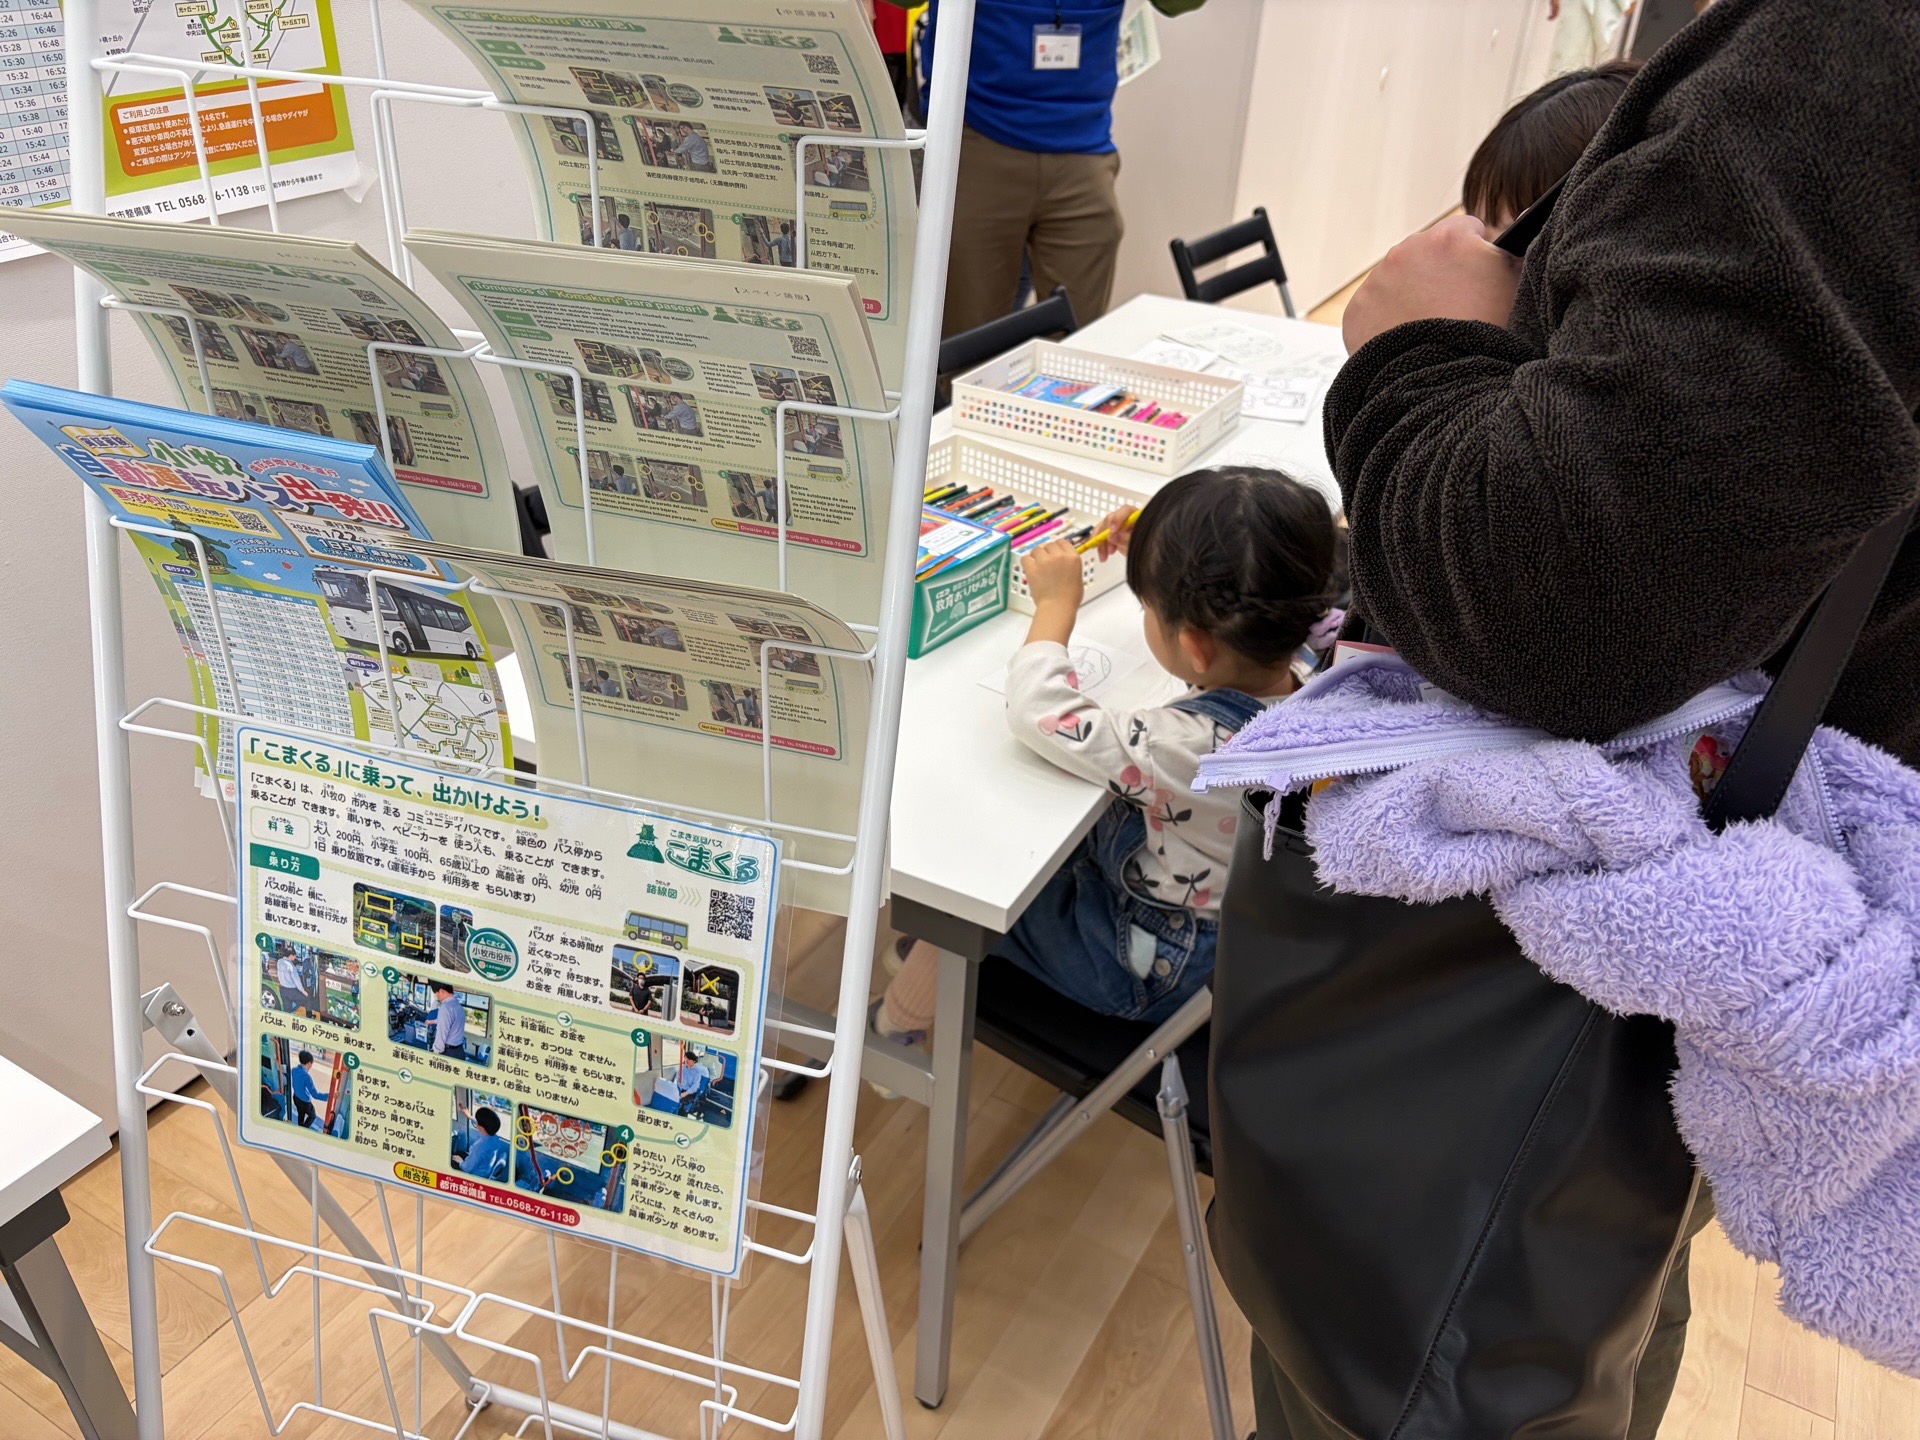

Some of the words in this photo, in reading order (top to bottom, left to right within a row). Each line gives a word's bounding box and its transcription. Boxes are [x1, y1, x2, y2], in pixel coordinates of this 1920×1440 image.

[31, 12, 52, 20] 16:44
[34, 25, 56, 34] 16:46
[38, 39, 60, 48] 16:48
[3, 58, 25, 66] 15:30
[42, 53, 63, 62] 16:50
[7, 71, 29, 80] 15:32
[46, 67, 66, 76] 16:52
[10, 86, 32, 94] 15:34
[14, 99, 36, 108] 15:36
[123, 106, 169, 120] ご利用上の注意
[18, 113, 39, 122] 15:38
[22, 126, 43, 136] 15:40
[26, 140, 46, 149] 15:42
[29, 153, 50, 162] 15:44
[32, 166, 53, 176] 15:46
[36, 179, 57, 189] 15:48
[40, 191, 60, 201] 15:50
[155, 198, 176, 212] TEL
[178, 185, 250, 208] 0568-6-1138
[625, 300, 653, 309] para
[656, 302, 701, 313] pasear!
[152, 440, 246, 479] 小牧
[322, 529, 357, 541] 1/22
[251, 771, 312, 795] 「こまくる」は、
[320, 788, 346, 804] 小牧の
[351, 796, 376, 812] 市内を
[383, 804, 400, 818] 走る
[407, 810, 505, 842] コミュニティバスです。
[516, 834, 546, 850] 緑色の
[553, 842, 602, 862] バス停から
[268, 819, 293, 835] 料金
[250, 788, 295, 808] 乗ることが
[302, 800, 340, 818] できます。
[347, 812, 384, 831] 車いすや、
[393, 824, 447, 846] ベビーカーを
[454, 838, 495, 857] 使う人も、
[504, 849, 553, 869] 乗ることが
[561, 861, 605, 880] できます。
[268, 854, 300, 872] 乗り方
[313, 824, 330, 836] 大人
[336, 829, 365, 846] 200円、
[370, 839, 397, 855] 小学生
[404, 848, 431, 863] 100円、
[439, 855, 489, 876] 65歳以上の
[495, 868, 525, 884] 高齢者
[559, 881, 579, 896] 幼児
[585, 887, 601, 901] 0円
[314, 840, 325, 852] 1日
[442, 873, 479, 891] 利用券を
[665, 838, 760, 887] こまくる
[264, 879, 302, 897] バスの前と
[308, 890, 326, 903] 横に、
[646, 882, 677, 900] 路線図
[264, 895, 304, 914] 路線番号と
[308, 906, 347, 925] 最終行先が
[264, 911, 321, 934] 書いてあります。
[260, 936, 267, 946] 1
[528, 928, 554, 943] バスが
[560, 935, 603, 955] 来る時間が
[471, 945, 511, 964] 小牧市役所
[527, 945, 580, 966] 近くなったら、
[387, 969, 395, 981] 2
[526, 962, 560, 979] バス停で
[566, 971, 604, 989] 待ちます。
[526, 978, 551, 993] お金を
[557, 986, 603, 1006] 用意します。
[260, 1013, 286, 1029] バスは、
[291, 1021, 306, 1033] 前の
[312, 1026, 339, 1041] ドアから
[343, 1035, 375, 1052] 乗ります。
[498, 1014, 515, 1026] 先に
[520, 1019, 554, 1036] 料金箱に
[560, 1028, 585, 1043] お金を
[636, 1031, 644, 1043] 3
[498, 1030, 534, 1048] 入れます。
[540, 1040, 573, 1057] おつりは
[578, 1050, 616, 1067] でません。
[347, 1054, 355, 1066] 5
[392, 1048, 423, 1065] 運転手に
[429, 1058, 460, 1075] 利用券を
[497, 1046, 538, 1064] 運転手から
[544, 1057, 577, 1073] 利用券を
[582, 1066, 625, 1085] もらいます。
[356, 1072, 390, 1089] 降ります。
[497, 1062, 529, 1078] 同じ日に
[534, 1071, 567, 1088] もう一度
[572, 1081, 618, 1101] 乗るときは、
[358, 1088, 379, 1101] ドアが
[384, 1095, 434, 1117] 2つあるバスは
[356, 1103, 386, 1119] 後ろから
[390, 1112, 423, 1130] 降ります。
[636, 1112, 674, 1130] 座ります。
[356, 1118, 378, 1132] ドアが
[383, 1125, 425, 1145] 1つのバスは
[620, 1127, 629, 1140] 4
[355, 1134, 377, 1148] 前から
[382, 1141, 415, 1159] 降ります。
[632, 1146, 666, 1163] 降りたい
[671, 1156, 705, 1173] バス停の
[402, 1168, 430, 1185] 問合先
[439, 1179, 486, 1200] 都市整備課
[632, 1161, 681, 1183] アナウンスが
[686, 1176, 724, 1194] 流れたら、
[631, 1177, 680, 1199] 降車ボタンを
[685, 1192, 723, 1211] 押します。
[630, 1193, 666, 1211] バスには、
[672, 1205, 713, 1224] たくさんの
[628, 1208, 678, 1230] 降車ボタンが
[683, 1224, 719, 1242] あります。
